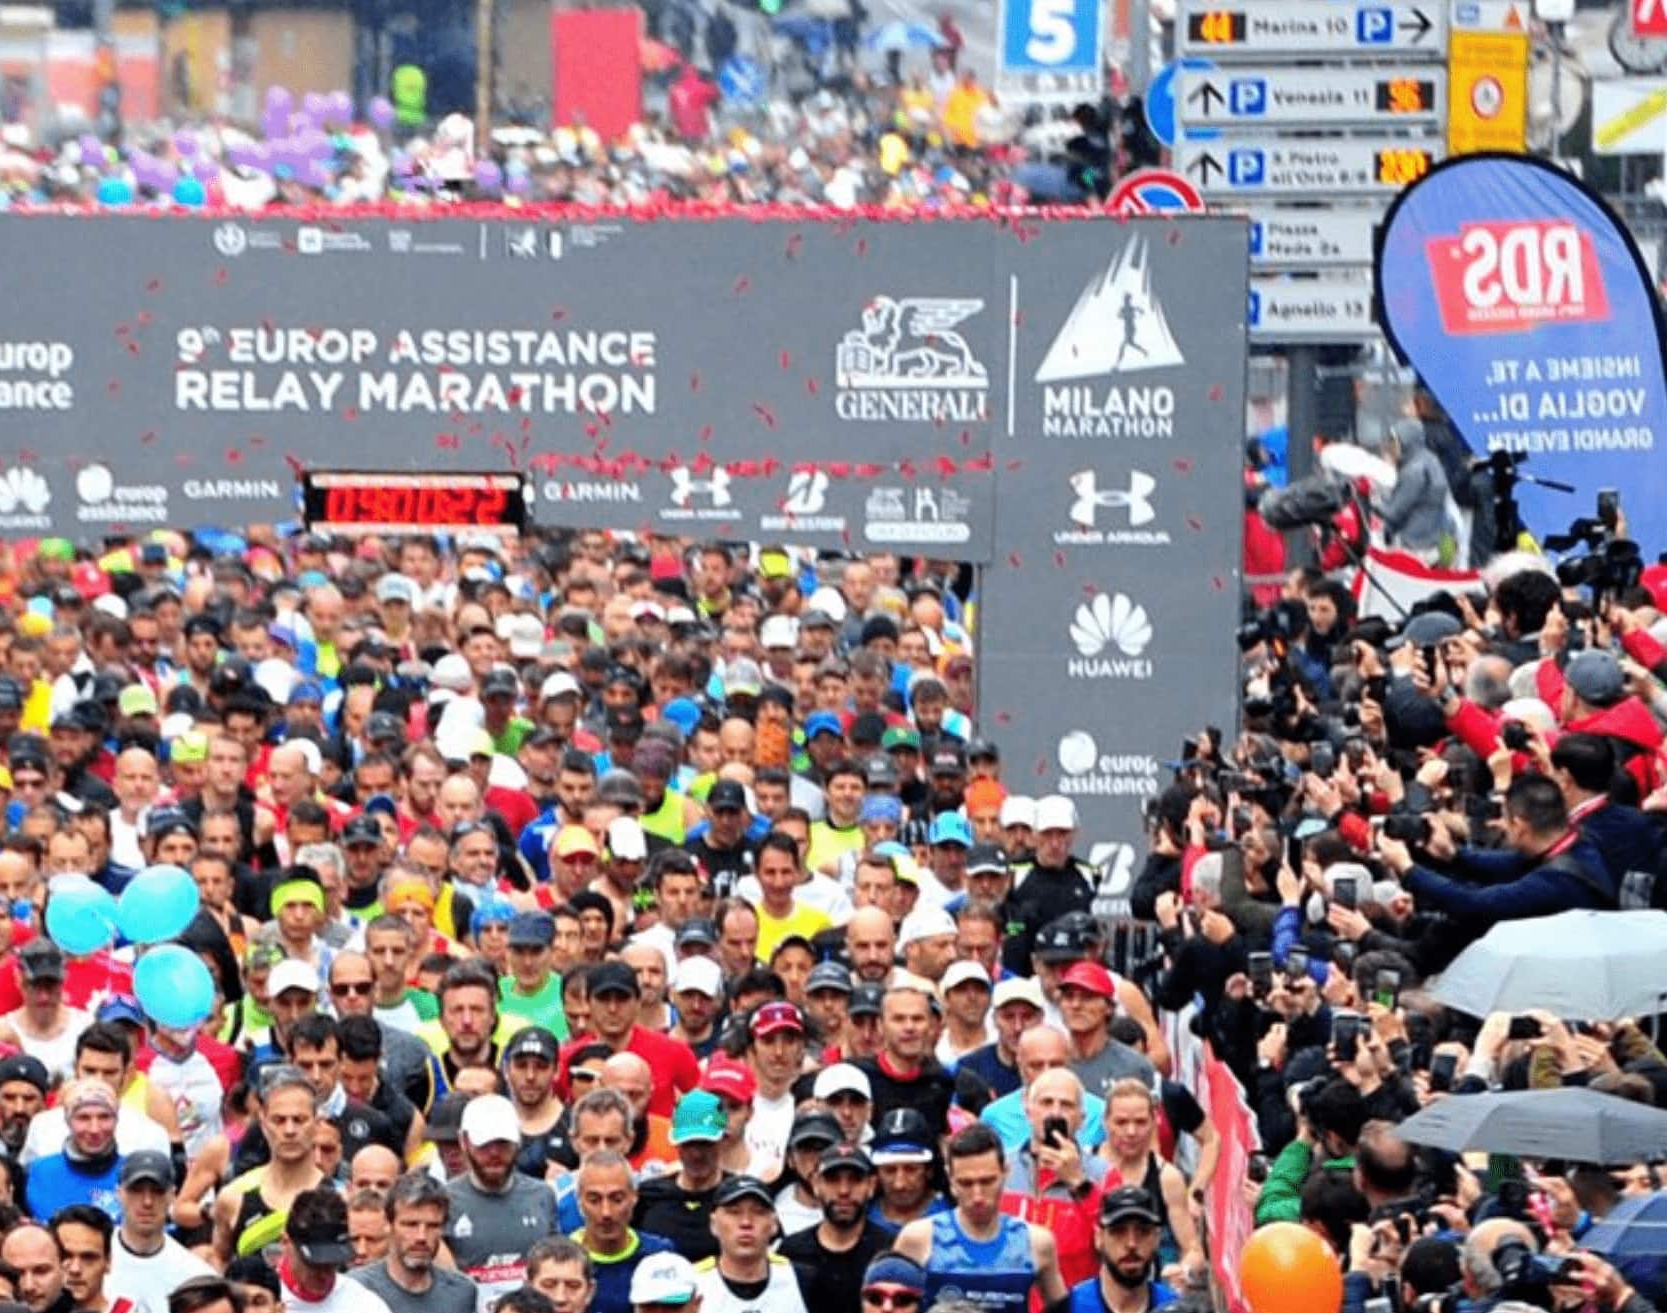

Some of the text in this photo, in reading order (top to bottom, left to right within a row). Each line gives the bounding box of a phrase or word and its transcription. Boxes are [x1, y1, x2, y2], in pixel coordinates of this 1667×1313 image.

[1026, 0, 1076, 62] 5
[229, 327, 378, 364] EUROP
[388, 330, 657, 367] ASSISTANCE
[176, 371, 657, 414] RELAY MARATHON
[835, 390, 989, 422] GENERALI
[1044, 386, 1175, 416] MILANO
[1043, 417, 1174, 438] MARATHON
[1069, 659, 1153, 679] HUAWEI
